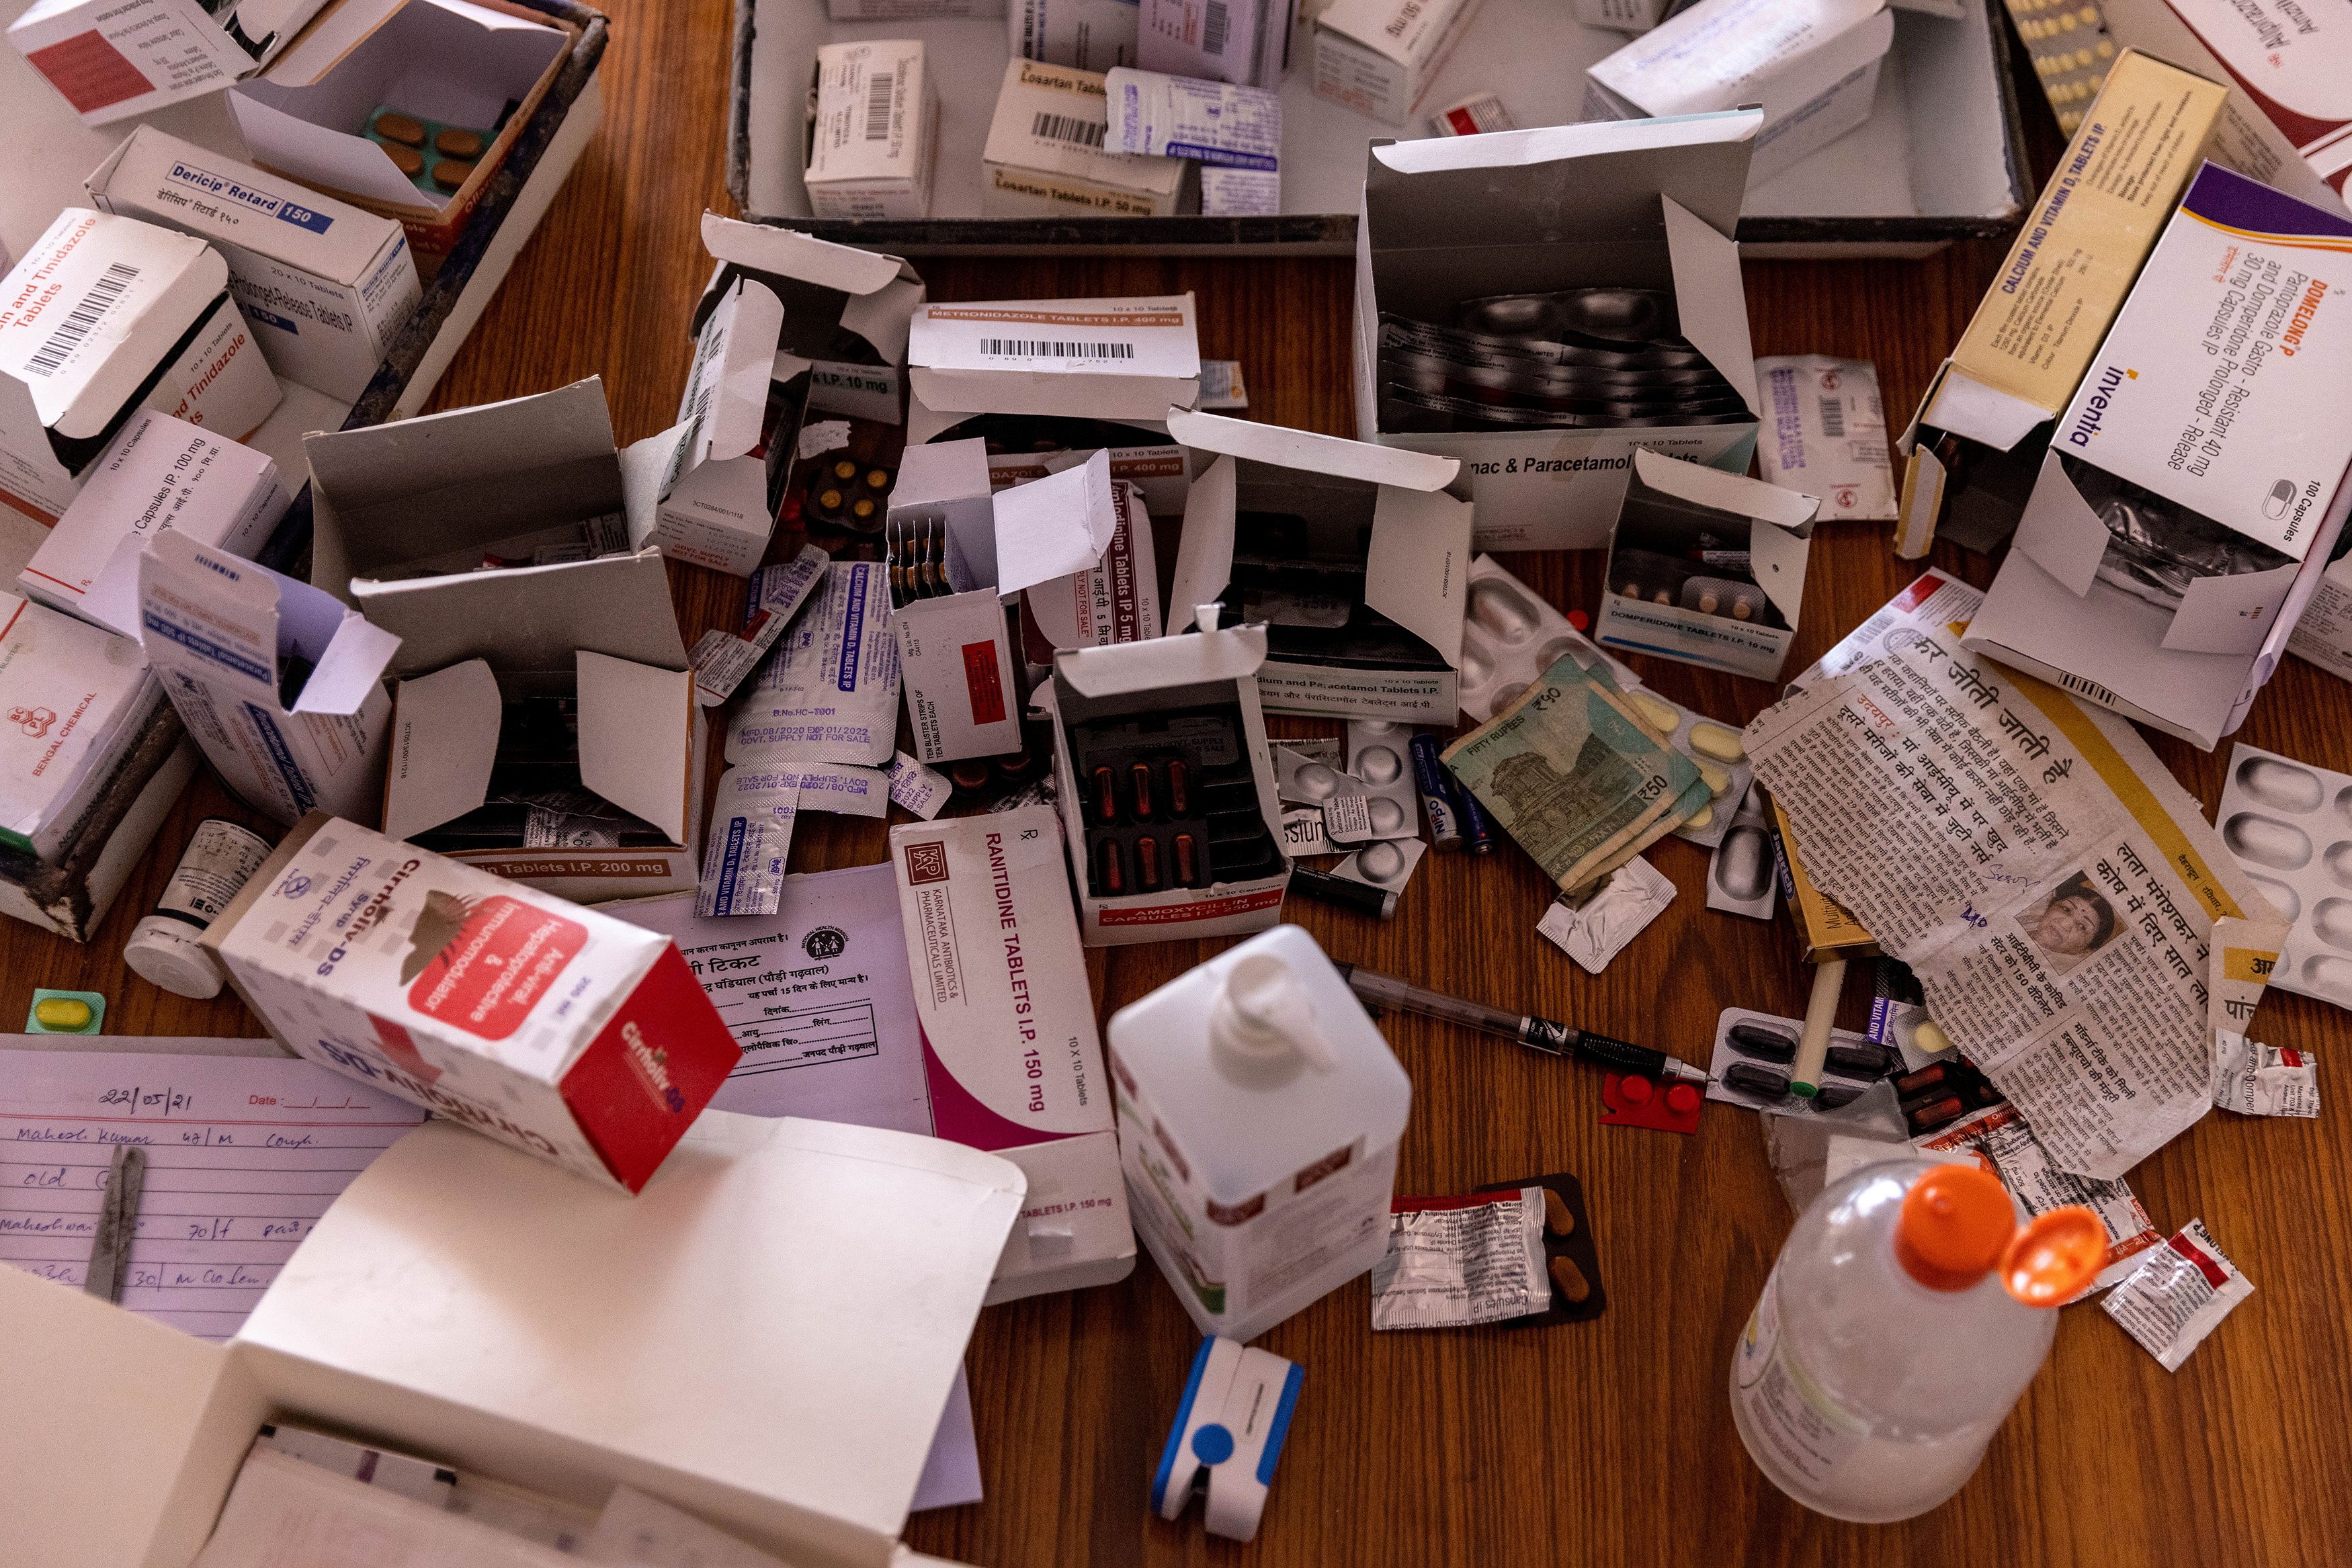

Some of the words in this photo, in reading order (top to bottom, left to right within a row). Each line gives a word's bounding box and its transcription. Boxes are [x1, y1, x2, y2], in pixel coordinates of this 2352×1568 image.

[1021, 69, 1073, 89] Losartan
[228, 185, 278, 210] Retard
[284, 205, 311, 222] 150
[1051, 188, 1091, 205] Tablets
[2003, 249, 2035, 294] CALCIUM
[2028, 226, 2047, 253] AND
[2040, 183, 2071, 225] VITAMIN
[2068, 139, 2101, 176] TABLETS
[13, 284, 38, 308] and
[32, 218, 96, 282] Tinidazole
[2243, 253, 2265, 270] 30
[2261, 260, 2281, 285] and
[308, 280, 344, 299] Tablets
[2026, 276, 2044, 304] Carbonate
[2230, 269, 2252, 289] mg
[13, 282, 63, 329] Tablets
[932, 310, 1046, 320] METRONIDAZOLE
[1051, 314, 1109, 322] TABLETS
[2206, 290, 2245, 340] Capsules
[2260, 270, 2309, 339] Pantoprazole
[341, 314, 352, 333] IP
[2223, 283, 2274, 357] Domperidone
[212, 322, 233, 347] Tablets
[187, 333, 246, 401] Tinidazole
[2242, 340, 2273, 376] Gastro
[866, 380, 887, 394] mg
[2195, 357, 2238, 417] Prolonged
[2069, 366, 2139, 447] inventia
[2210, 385, 2250, 439] Resistant
[110, 462, 120, 472] 10
[120, 448, 130, 457] 10
[127, 418, 152, 448] Capsules
[2167, 424, 2204, 470] Release
[2201, 439, 2222, 457] 40
[1159, 464, 1179, 472] mg
[1505, 458, 1517, 472] &
[1523, 455, 1632, 472] Paracetamol
[2187, 455, 2210, 477] mg
[134, 485, 171, 529] Capsules
[174, 453, 192, 472] 100
[188, 437, 206, 453] mg
[2306, 480, 2321, 497] 100
[259, 484, 278, 513] Capsules
[2283, 498, 2312, 541] Capsules
[1116, 554, 1130, 596] Tablets
[1079, 602, 1088, 615] FOR
[1123, 599, 1133, 611] IP
[1142, 614, 1150, 622] 10
[849, 609, 862, 638] VITAMIN
[1120, 614, 1133, 623] 5
[1611, 611, 1683, 630] DOMPERIDONE
[1687, 625, 1728, 641] TABLETS
[1761, 644, 1776, 654] mg
[1755, 631, 1779, 639] Tablets
[217, 651, 268, 680] Paracetamol
[843, 651, 856, 679] TABLETS
[915, 689, 923, 697] OF
[1284, 690, 1300, 699] और
[1382, 685, 1419, 694] Tablets
[918, 699, 928, 721] STRIPS
[927, 701, 936, 718] EACH
[1856, 693, 1896, 730] उदयपुर
[1949, 660, 2000, 710] जीती
[1999, 707, 2050, 760] जाती
[2043, 758, 2072, 783] है
[32, 738, 64, 777] BENGAL
[59, 692, 97, 738] CHEMICAL
[768, 734, 804, 743] SUPPLY
[826, 734, 845, 742] FOR
[847, 735, 872, 744] SALE
[922, 721, 930, 747] BLISTER
[931, 720, 941, 746] TABLETS
[1468, 737, 1488, 757] FIFTY
[1489, 716, 1525, 744] RUPEES
[1836, 704, 1866, 729] दूसरे
[1863, 726, 1900, 762] मरीजों
[1896, 760, 1915, 781] की
[1912, 778, 1936, 803] सेवा
[907, 784, 927, 810] SUPPLY
[1638, 775, 1668, 801] ₹50
[1917, 752, 1961, 803] आईसीयू
[1972, 810, 1989, 828] पर
[1429, 799, 1446, 834] NIPPO
[501, 862, 566, 874] Tablets
[570, 863, 595, 872] I.P.
[599, 863, 630, 872] 200
[636, 863, 663, 874] mg
[721, 867, 734, 896] VITAMIN
[728, 829, 742, 857] TABLETS
[2178, 854, 2200, 881] देहरादून
[985, 832, 1016, 930] RANITIDINE
[1239, 884, 1282, 894] Capsules
[2117, 842, 2149, 875] लता
[2146, 877, 2197, 945] मंगेशकर
[317, 857, 421, 978] Cirrholiv-DS
[337, 892, 370, 928] Syrup
[1101, 909, 1195, 924] CAPSULES
[1134, 898, 1249, 916] AMOXYCILLIN
[2097, 858, 2128, 896] कोष
[2140, 911, 2168, 949] दिए
[2165, 944, 2193, 981] सात
[697, 945, 718, 954] करना
[921, 890, 941, 969] PHARMACEUTICALS
[933, 970, 948, 1004] LIMITED
[932, 888, 948, 938] KARNATAKA
[941, 940, 958, 990] ANTIBIOTICS
[471, 920, 563, 1022] Hepatoprotective
[708, 955, 761, 973] टिकट
[1003, 933, 1032, 1015] TABLETS
[715, 976, 756, 992] घंडियाल
[792, 984, 808, 994] दिन
[809, 982, 818, 990] के
[2013, 968, 2029, 987] 150
[2045, 981, 2068, 1009] कोविड
[1017, 1017, 1036, 1045] I.P.
[1068, 1036, 1079, 1048] 10
[1868, 1022, 1880, 1040] AND
[621, 1020, 671, 1090] Cirrholiv
[802, 1049, 827, 1059] जनपद
[1023, 1049, 1042, 1079] 150
[1073, 1059, 1083, 1072] 10
[2246, 1056, 2256, 1074] and
[2089, 1067, 2104, 1082] की
[2105, 1065, 2119, 1078] को
[99, 1087, 192, 1115] 22/05/21
[249, 1094, 277, 1106] Date
[1029, 1084, 1045, 1113] mg
[1075, 1072, 1089, 1108] Tablets
[1021, 1202, 1063, 1219] TABLETS
